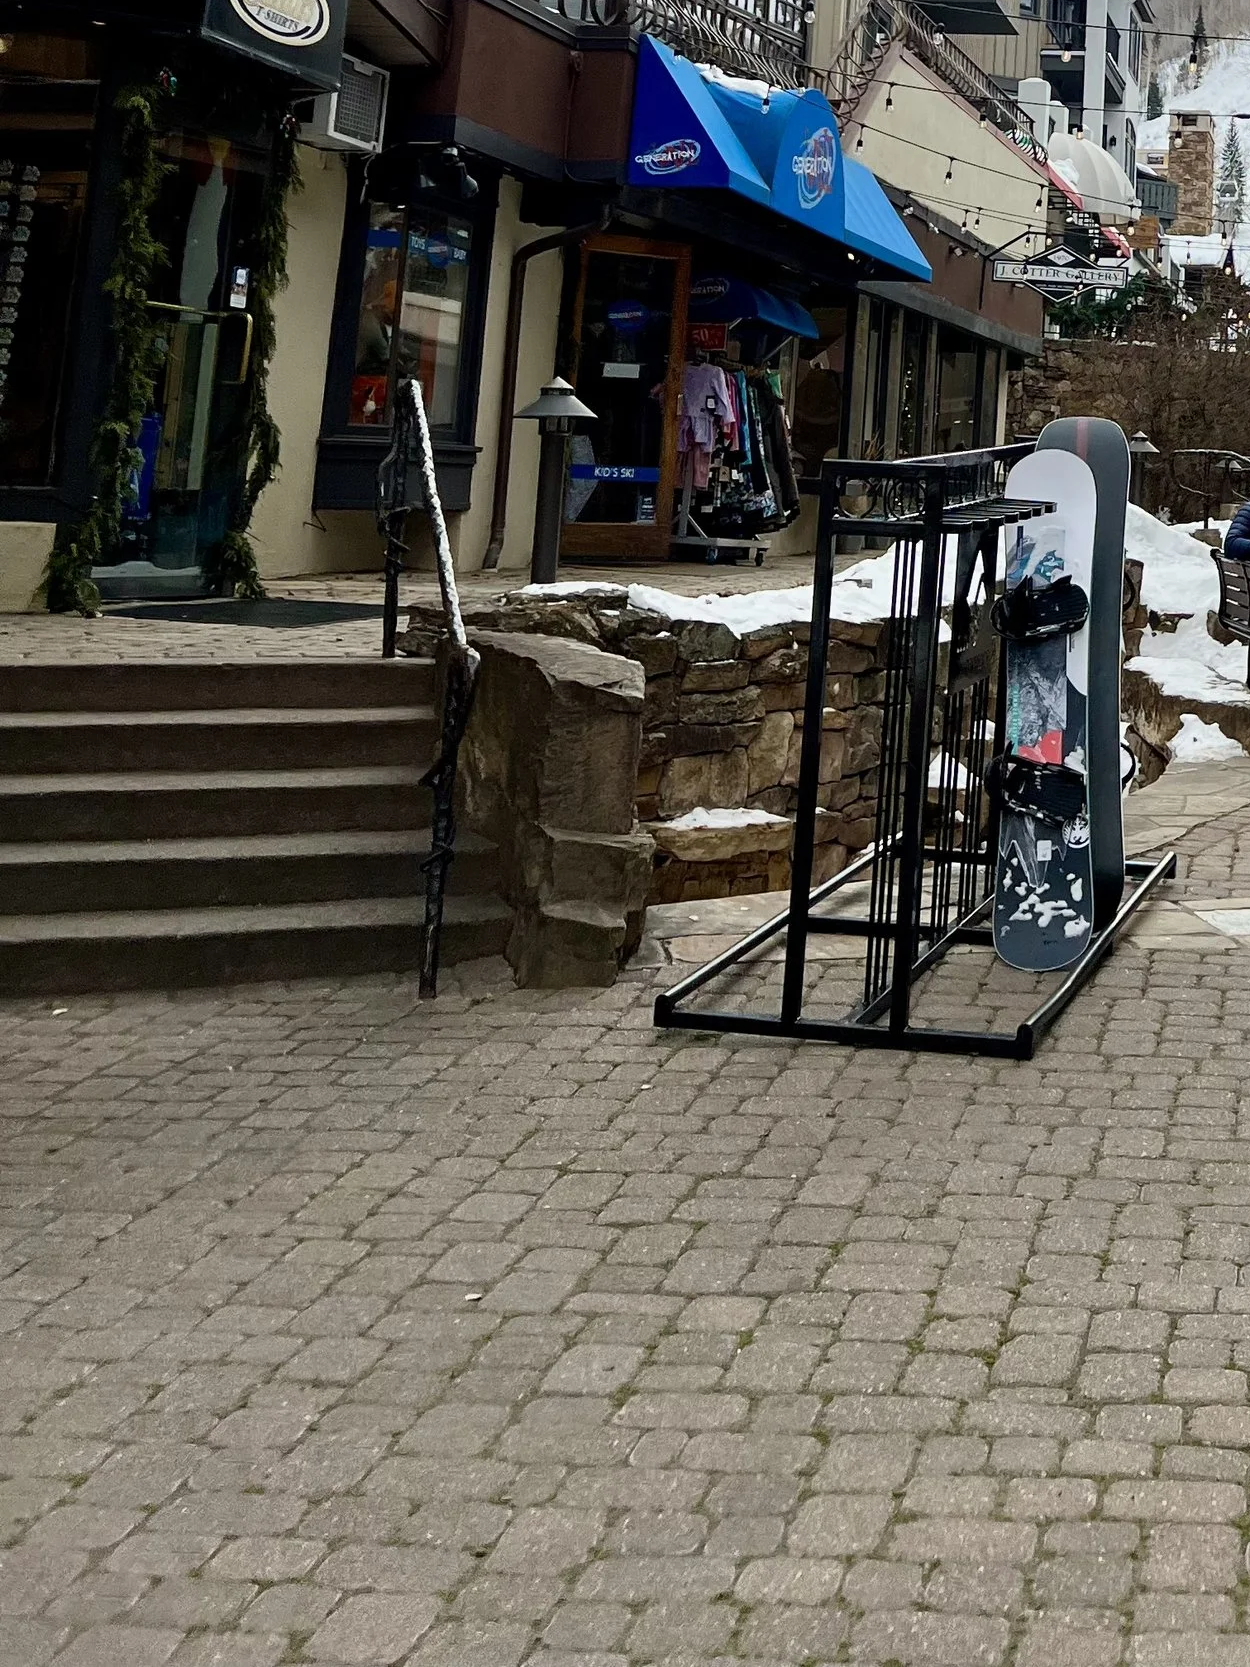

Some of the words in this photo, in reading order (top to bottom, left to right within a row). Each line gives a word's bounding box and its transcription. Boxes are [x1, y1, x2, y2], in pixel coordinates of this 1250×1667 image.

[256, 6, 300, 32] T-SHIRTS
[634, 149, 695, 164] GENERATION
[594, 466, 618, 478] KID'S
[620, 467, 635, 478] SKI
